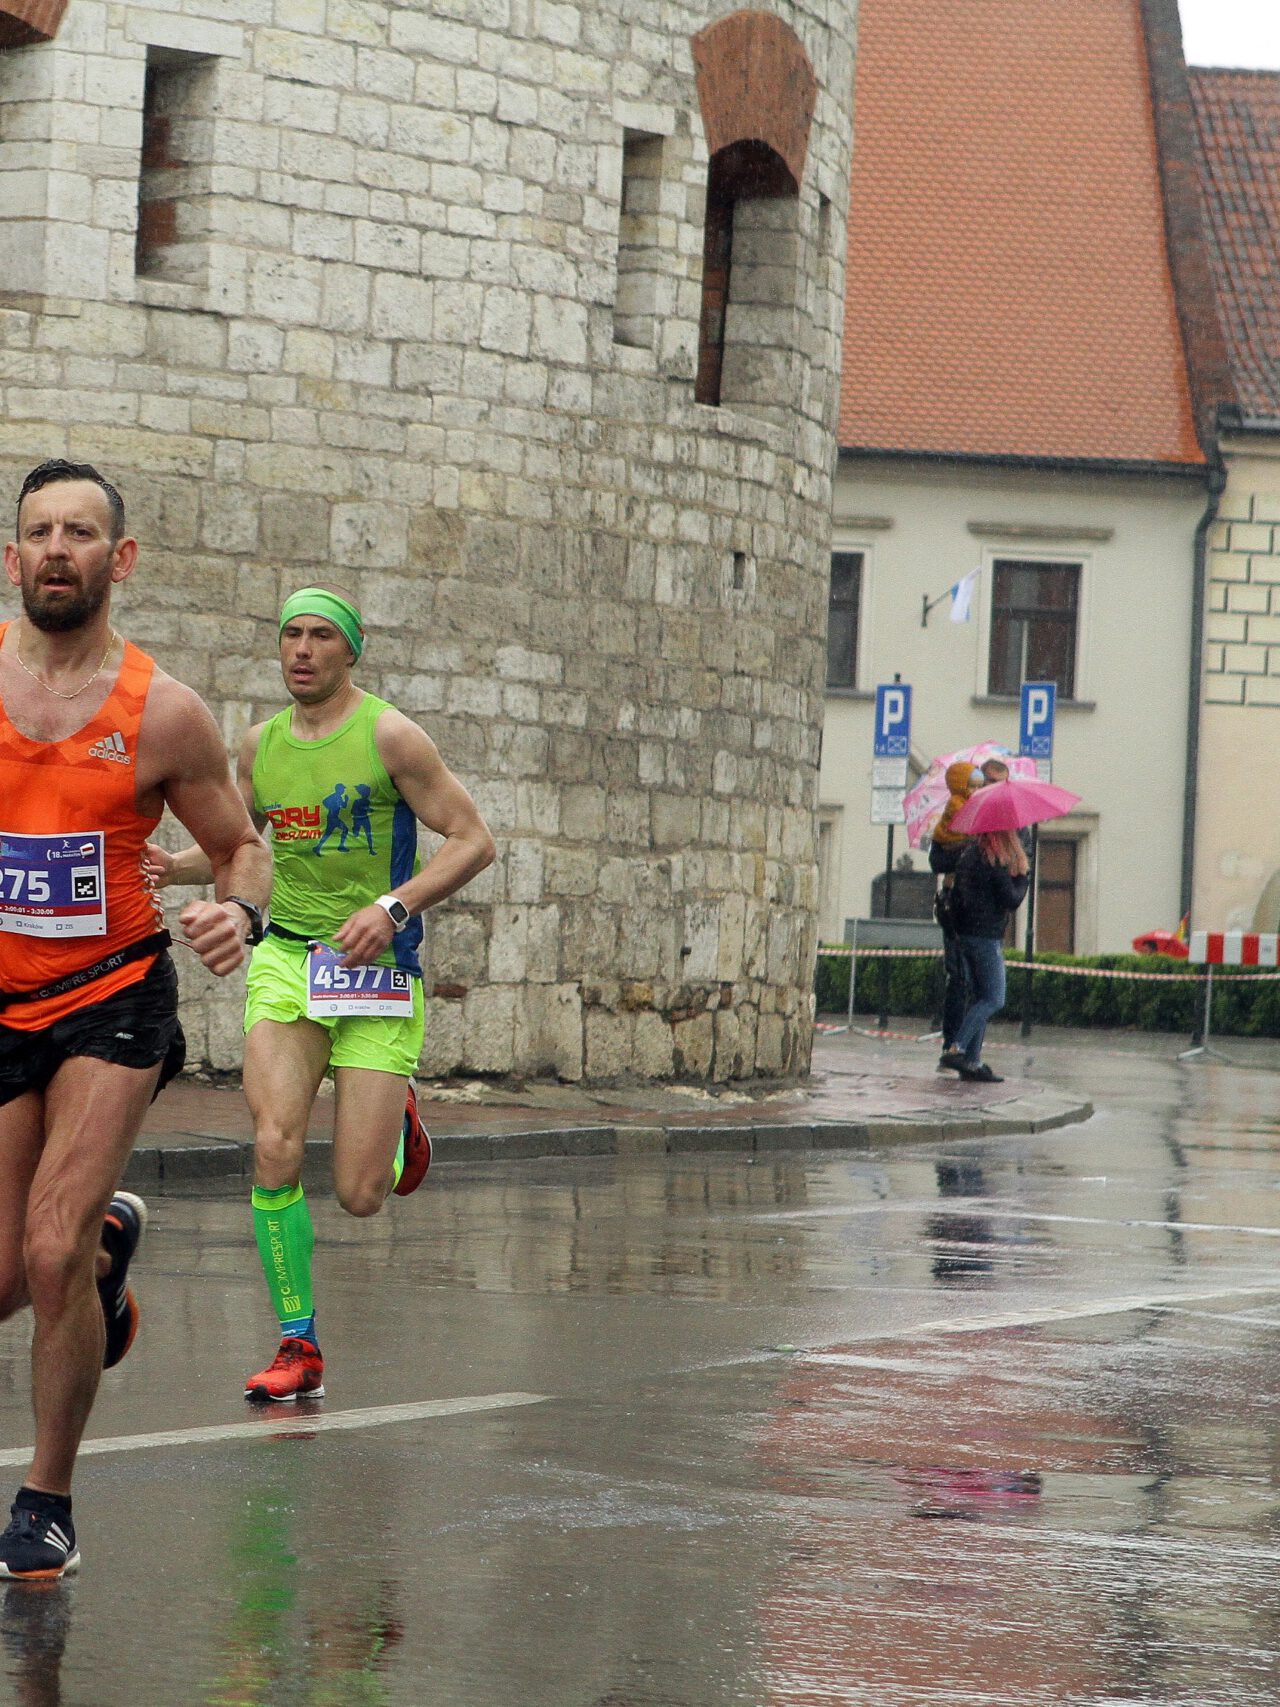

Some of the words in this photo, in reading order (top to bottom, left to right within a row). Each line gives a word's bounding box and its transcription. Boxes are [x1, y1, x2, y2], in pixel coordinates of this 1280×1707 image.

[882, 689, 904, 736] P
[1027, 689, 1049, 736] P
[88, 747, 131, 765] adidas
[313, 965, 385, 989] 4577
